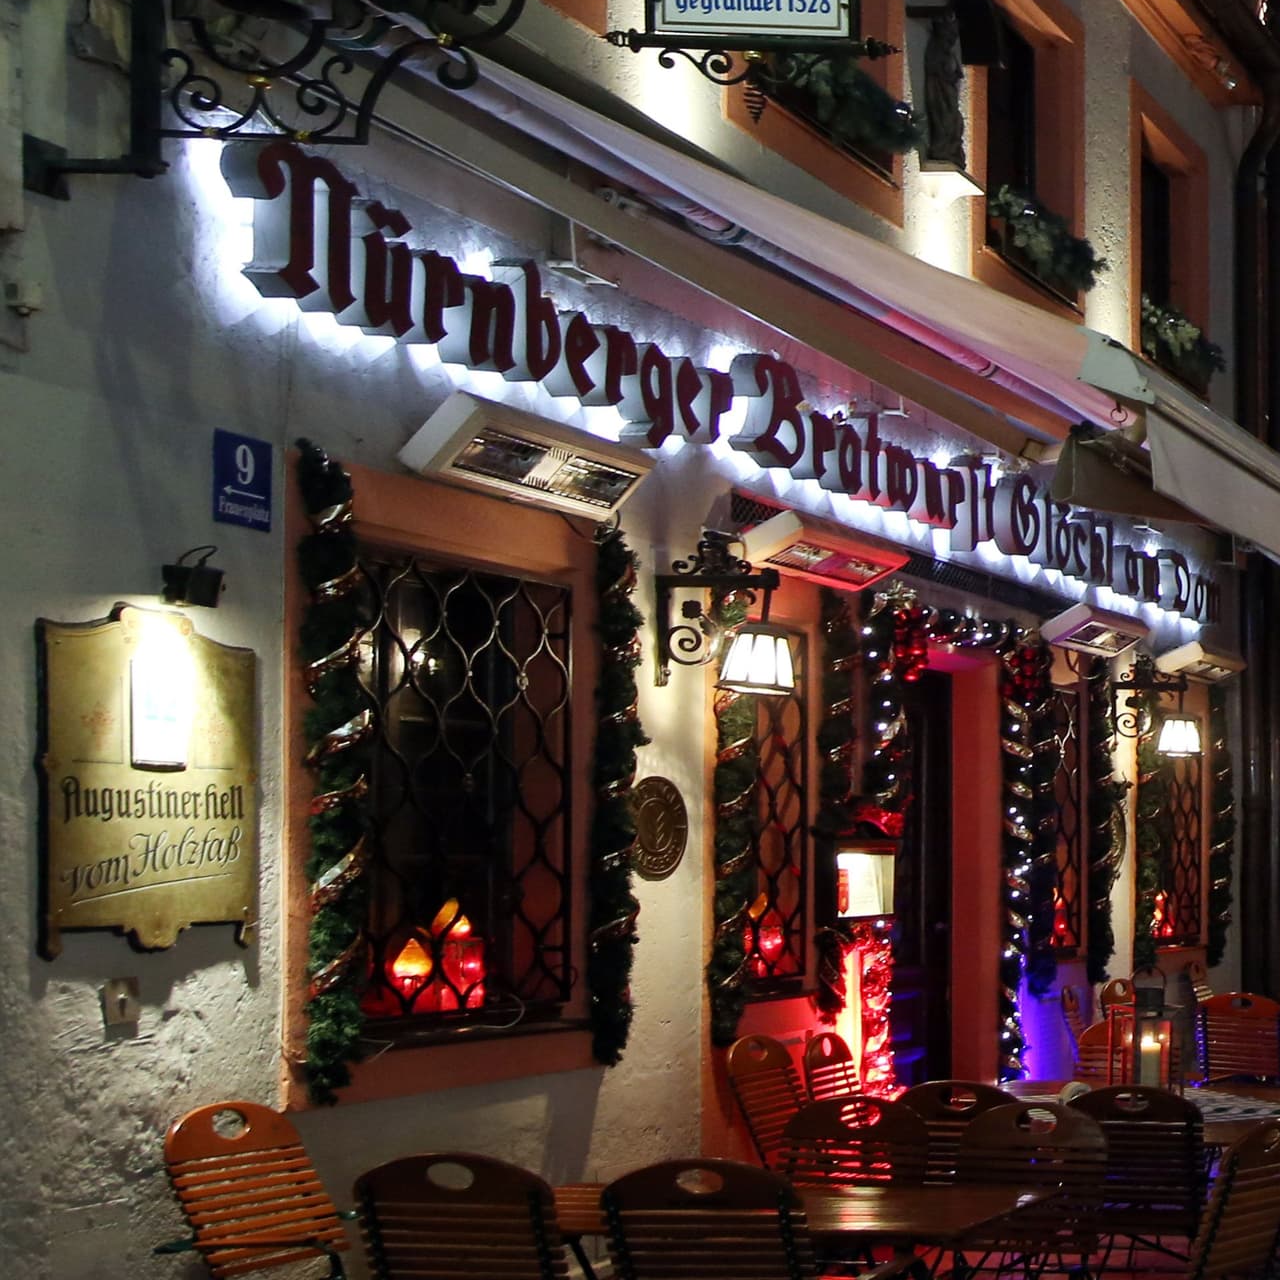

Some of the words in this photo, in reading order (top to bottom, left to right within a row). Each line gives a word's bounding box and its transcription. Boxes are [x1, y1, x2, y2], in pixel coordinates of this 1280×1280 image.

[257, 141, 734, 449] Nürnberger
[1011, 475, 1115, 587] Glöckl
[1125, 549, 1162, 603] am
[1173, 550, 1220, 624] Dom
[234, 443, 255, 486] 9
[217, 495, 270, 524] Frauenplatz
[59, 853, 130, 898] vom
[129, 825, 242, 878] Holzfaß
